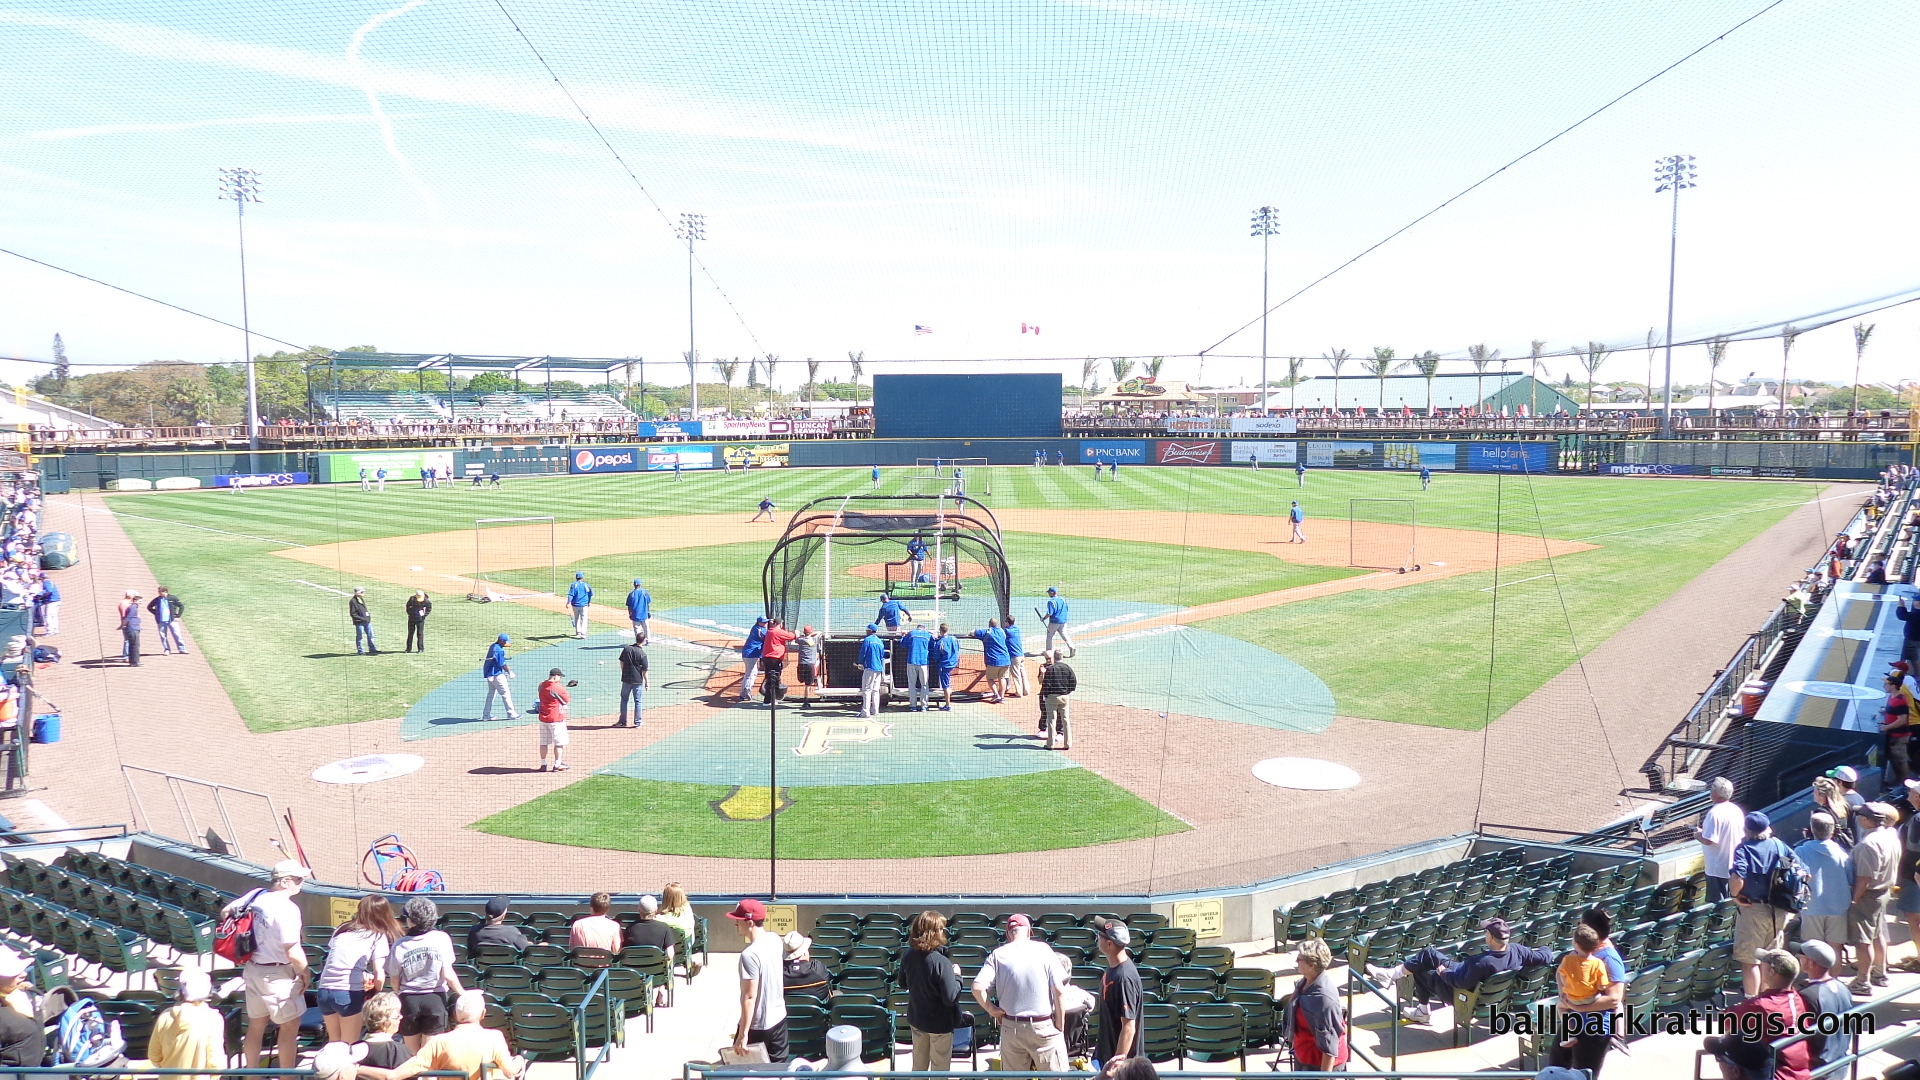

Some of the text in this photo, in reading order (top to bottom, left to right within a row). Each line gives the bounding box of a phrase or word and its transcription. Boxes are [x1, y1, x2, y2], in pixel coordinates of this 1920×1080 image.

[1096, 449, 1140, 457] PNC BANK
[1163, 448, 1213, 457] Budweiser
[595, 452, 632, 467] pepsi
[1610, 464, 1672, 475] metroPCS
